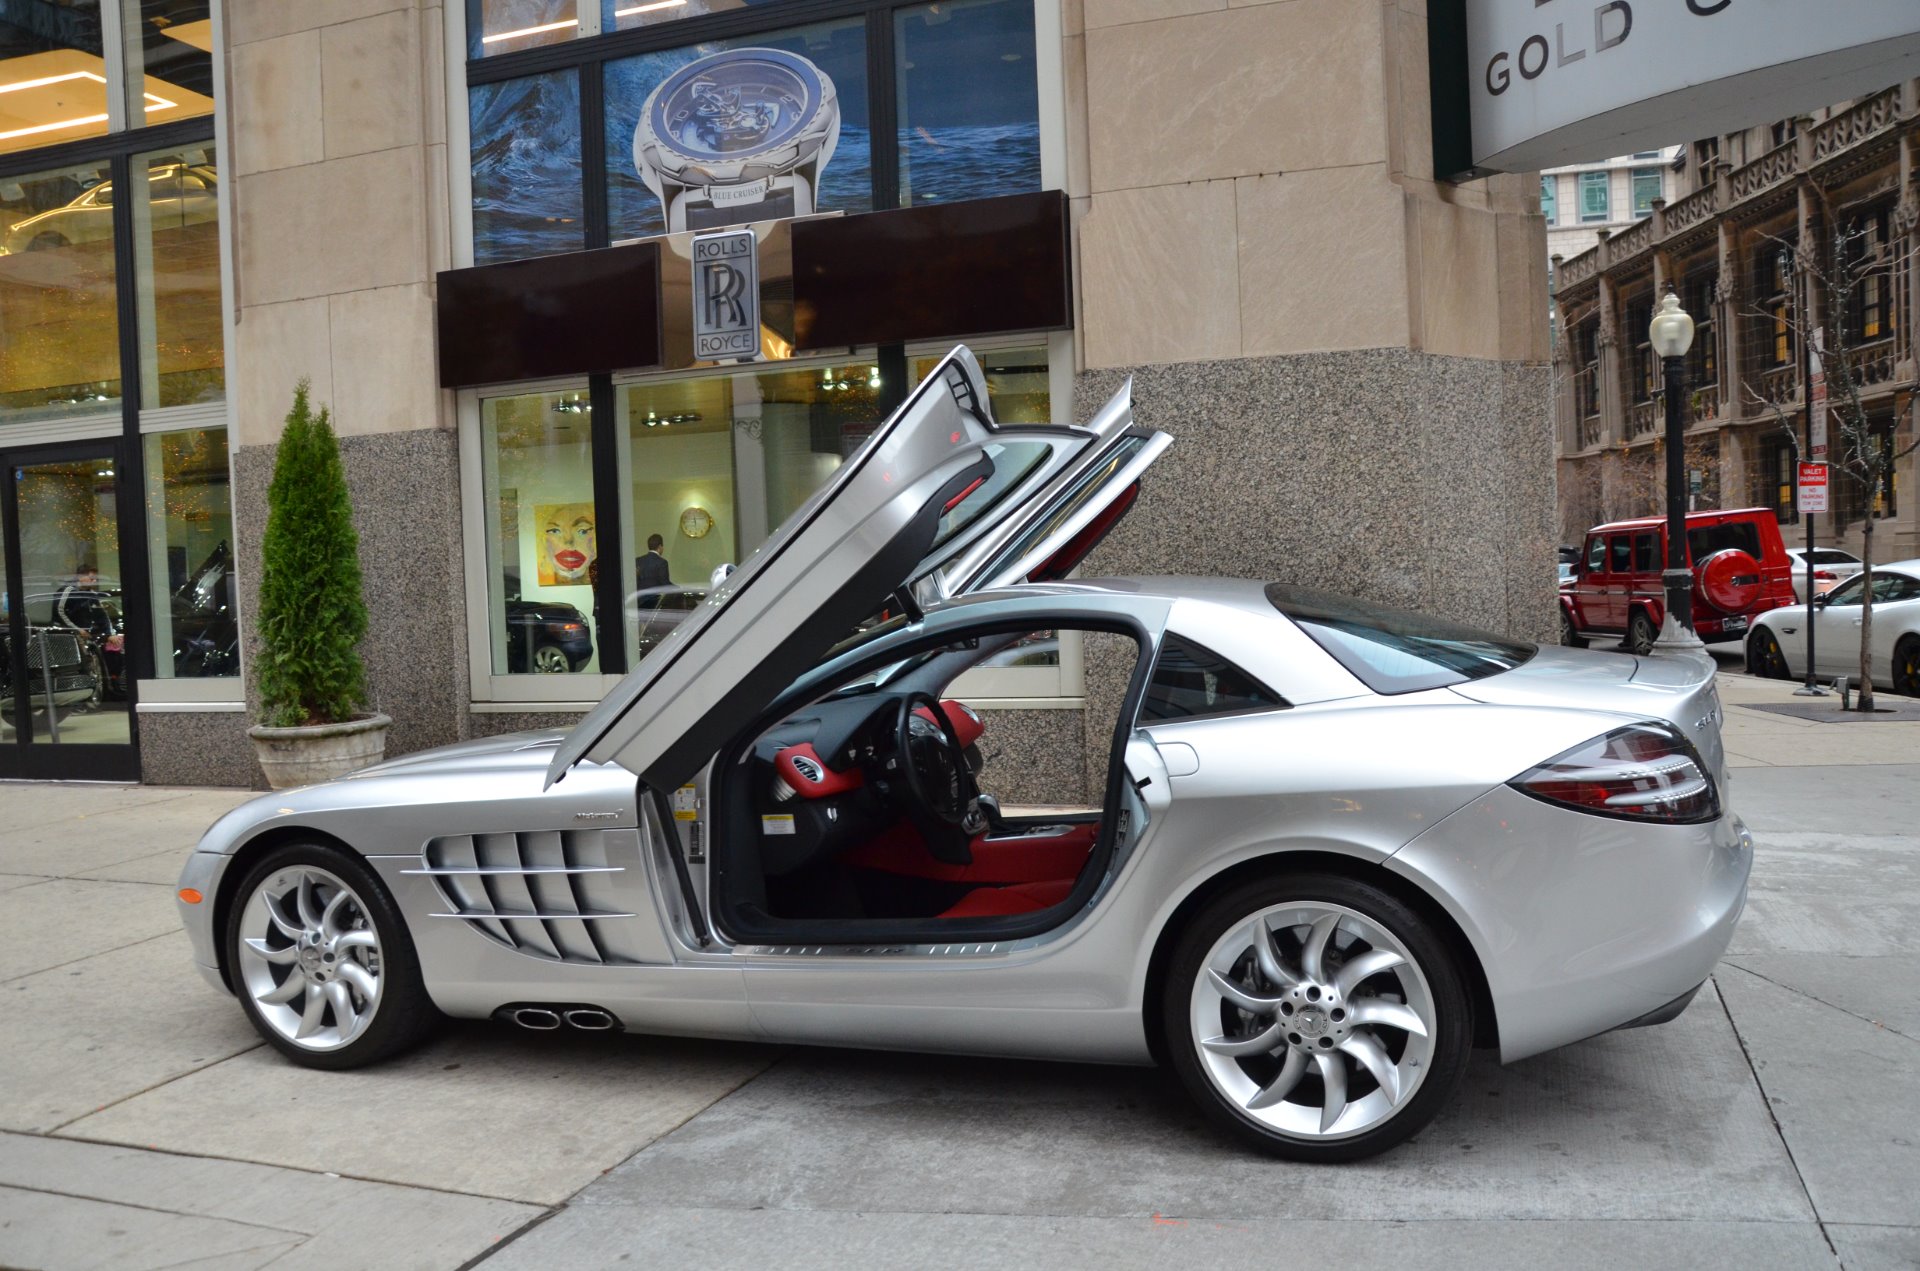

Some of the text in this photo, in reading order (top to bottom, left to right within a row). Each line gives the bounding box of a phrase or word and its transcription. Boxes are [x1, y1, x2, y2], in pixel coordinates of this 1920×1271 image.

[1485, 0, 1633, 97] GOLD
[713, 186, 764, 200] BLUE CRUISER
[698, 238, 747, 258] ROLLS
[701, 333, 751, 352] ROYCE
[1695, 709, 1715, 732] SLR
